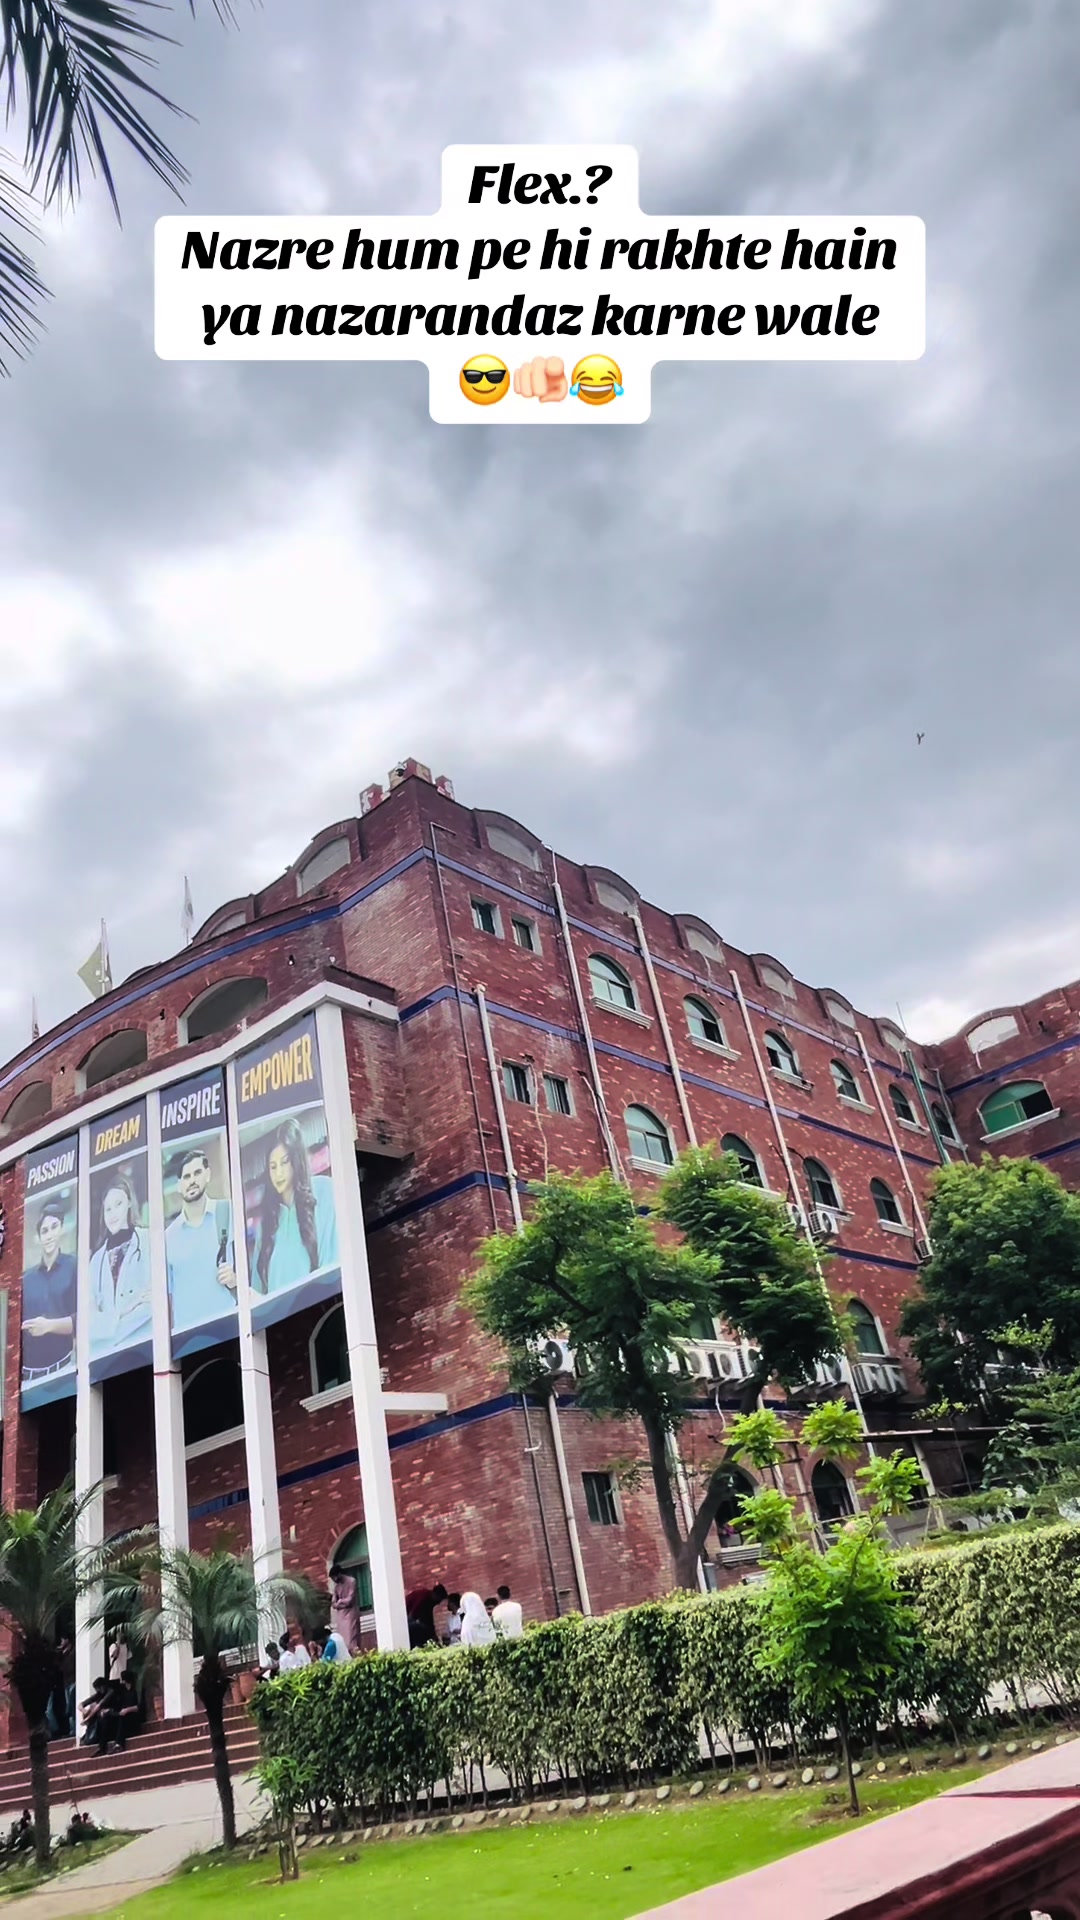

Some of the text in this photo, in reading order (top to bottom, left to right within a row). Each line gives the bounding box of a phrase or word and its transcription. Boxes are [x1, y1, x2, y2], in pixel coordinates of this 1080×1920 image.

[241, 1033, 314, 1102] EMPOWER
[161, 1082, 221, 1129] INSPIRE
[95, 1114, 141, 1156] DREAM
[27, 1150, 75, 1188] PASSION
